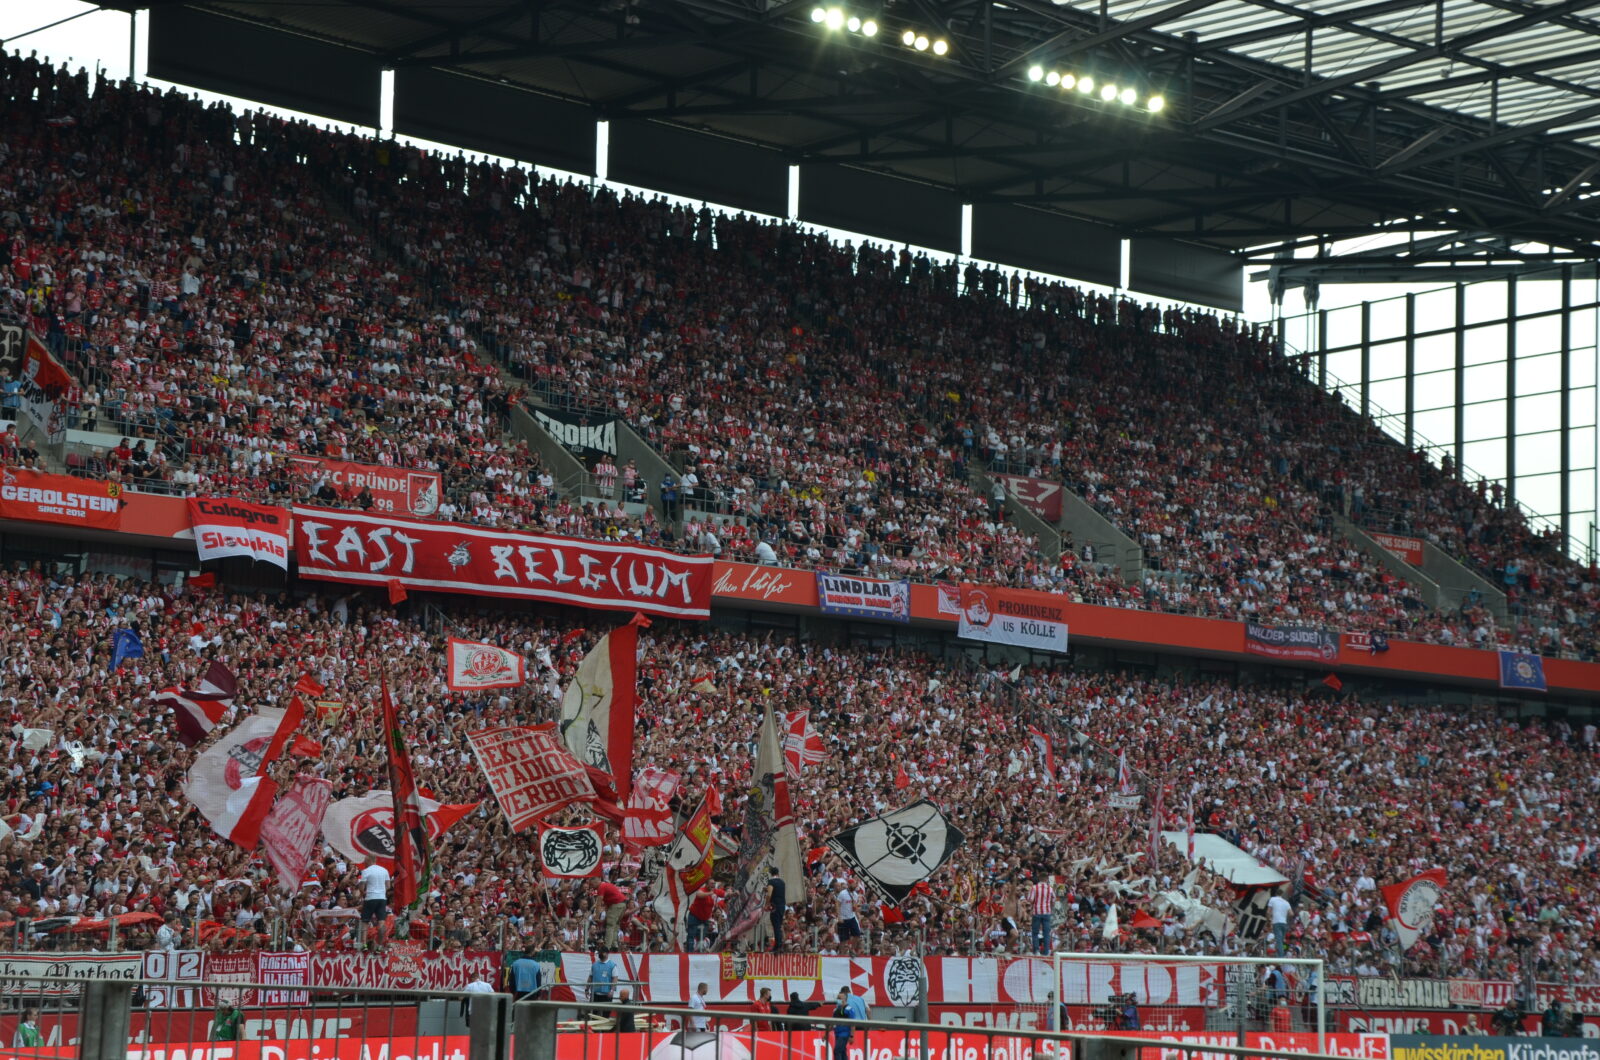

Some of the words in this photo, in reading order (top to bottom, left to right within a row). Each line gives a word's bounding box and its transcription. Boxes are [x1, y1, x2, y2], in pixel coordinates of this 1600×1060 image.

[535, 410, 617, 456] TROIKA
[347, 472, 407, 493] FRÜNDE
[1, 485, 118, 513] GEROLSTEIN
[38, 505, 64, 515] SINCE
[66, 508, 86, 518] 2012
[198, 501, 279, 525] Cologne
[302, 520, 421, 573] EAST
[490, 545, 692, 604] BELGIUM
[824, 579, 891, 597] LINDLAR
[998, 600, 1062, 620] PROMINENZ
[1003, 621, 1015, 632] US
[1021, 620, 1056, 638] KÖLLE
[488, 752, 582, 793] STADION
[500, 772, 590, 817] VERBOT
[747, 953, 819, 977] STADIONVERBOT
[208, 1018, 352, 1040] EWE
[813, 1038, 893, 1060] Dnke
